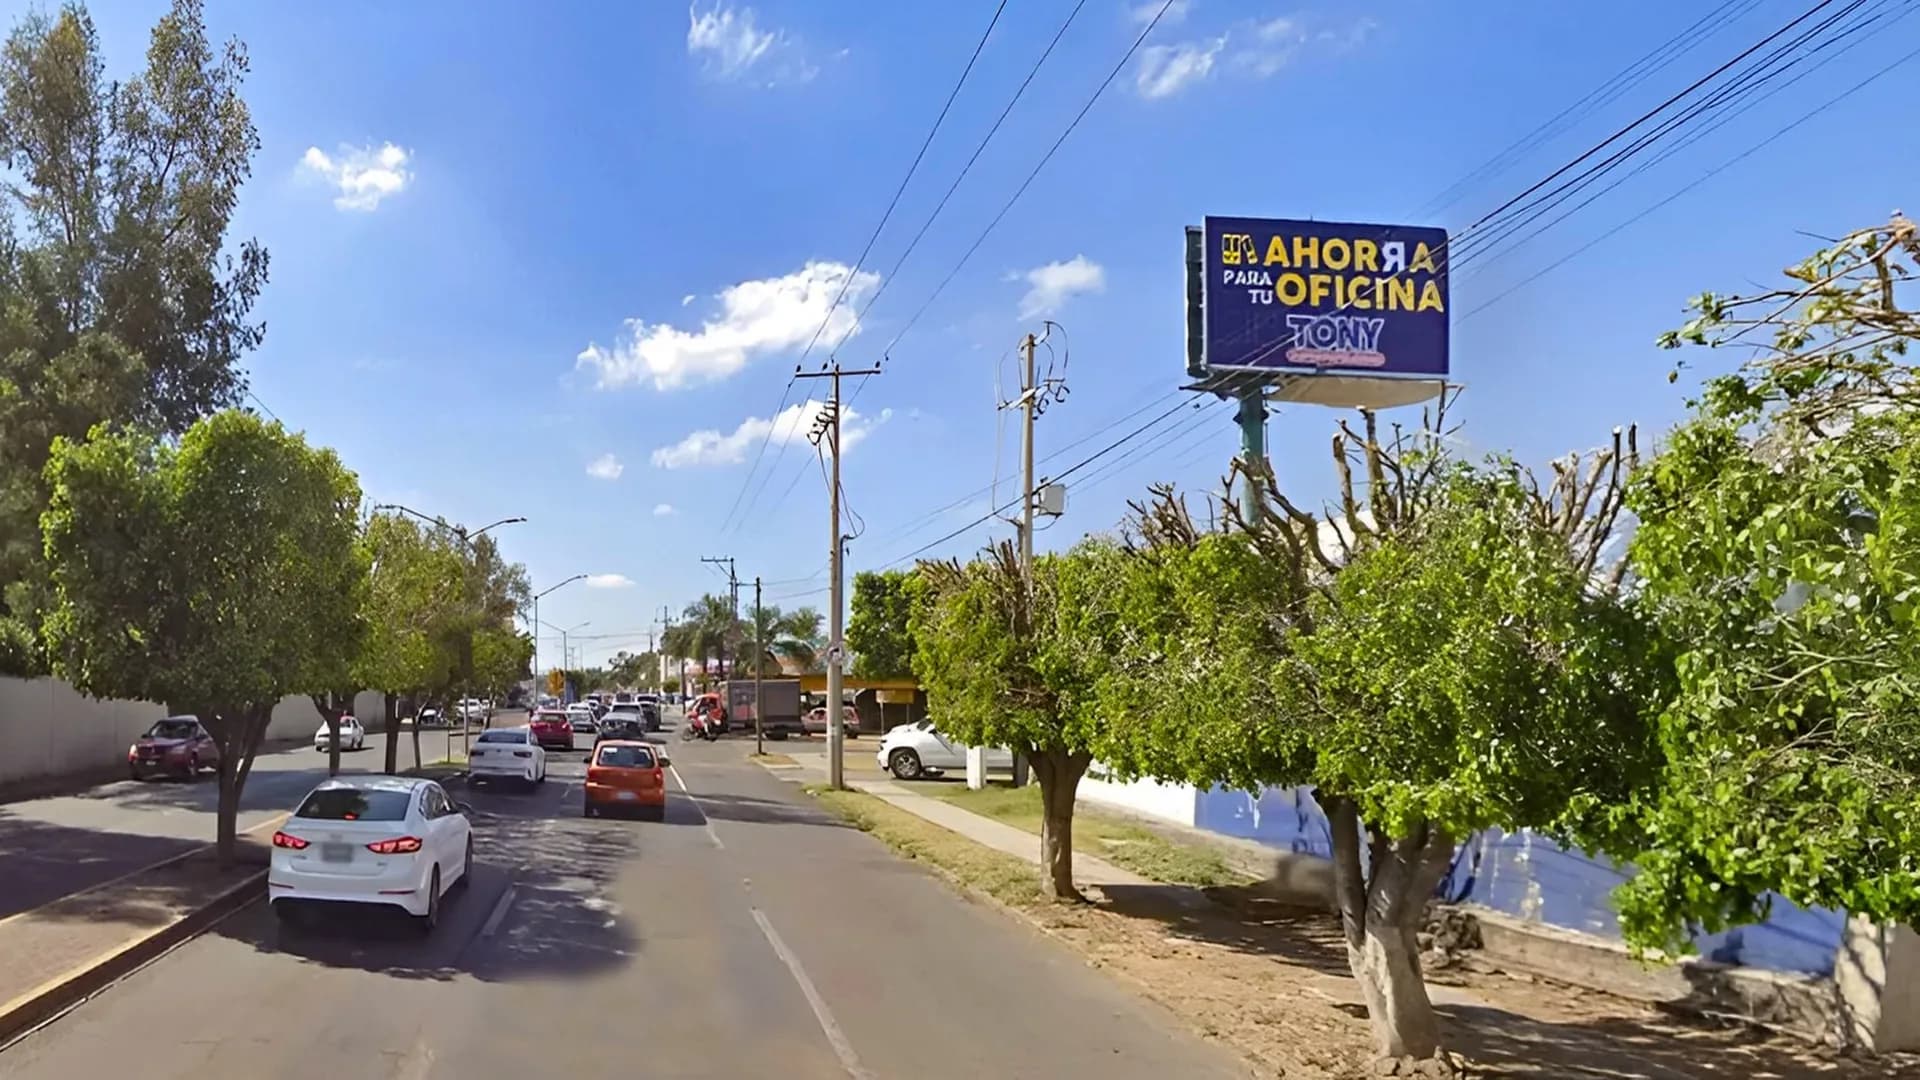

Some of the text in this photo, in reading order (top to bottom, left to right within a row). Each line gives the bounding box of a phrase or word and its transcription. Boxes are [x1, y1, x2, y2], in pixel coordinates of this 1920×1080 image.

[1263, 235, 1436, 274] AHORRA
[1223, 269, 1273, 286] PARA
[1248, 272, 1445, 313] TU OFICINA
[1286, 314, 1385, 352] TONY
